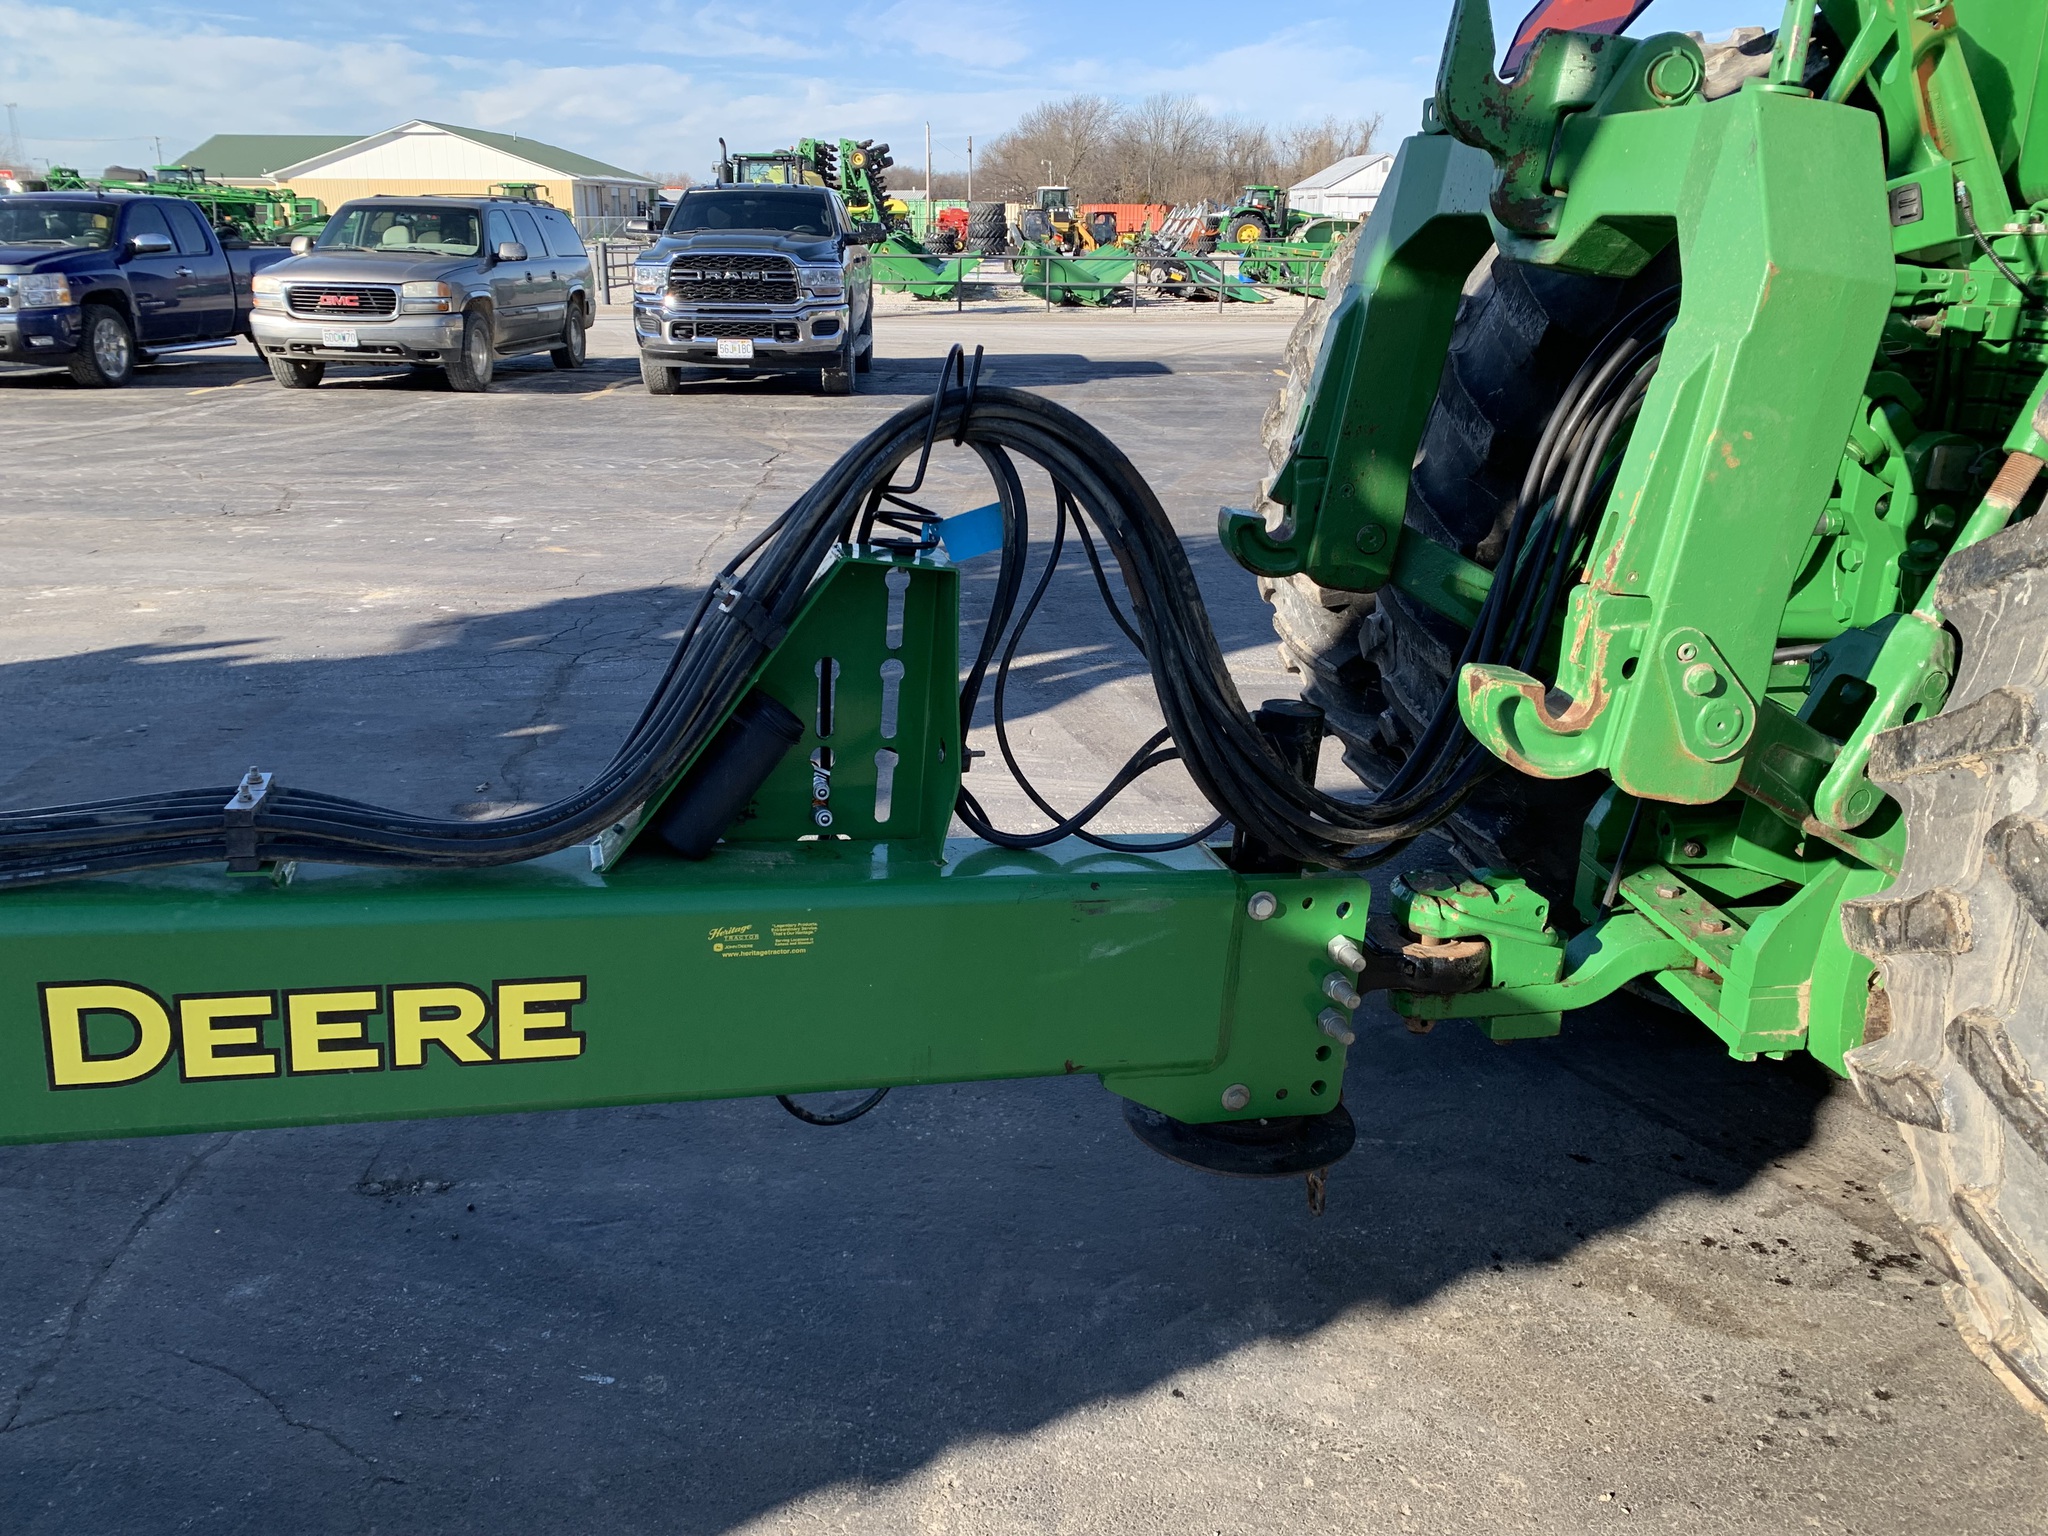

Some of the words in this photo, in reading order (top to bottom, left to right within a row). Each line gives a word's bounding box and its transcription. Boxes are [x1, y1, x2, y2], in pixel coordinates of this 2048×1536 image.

[704, 271, 760, 280] RAM
[320, 295, 359, 306] GMC
[707, 925, 752, 941] Heritage
[722, 948, 807, 958] www.heritagetractor.com
[40, 977, 586, 1089] DEERE
